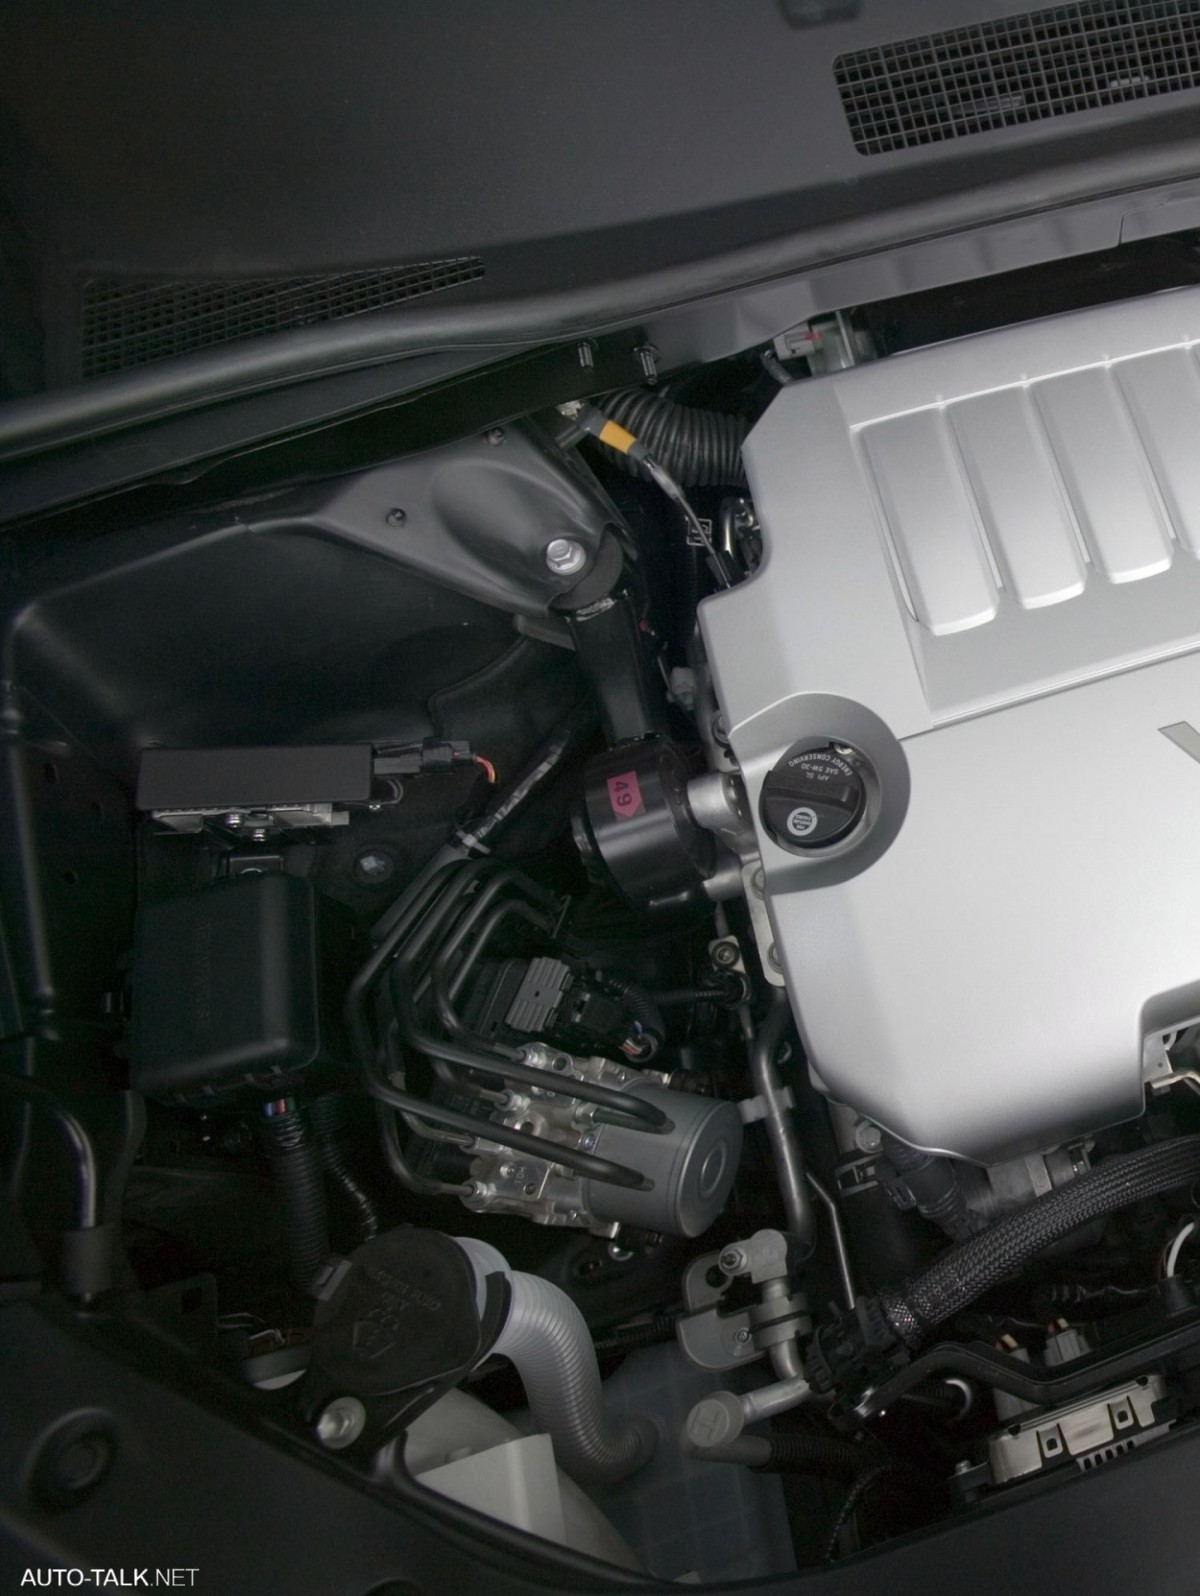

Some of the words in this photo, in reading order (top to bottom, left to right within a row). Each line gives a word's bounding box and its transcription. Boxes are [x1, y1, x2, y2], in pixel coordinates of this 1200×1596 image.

[788, 753, 830, 766] CONSERVING
[832, 756, 852, 776] ENERGY
[801, 763, 823, 772] 5W-30
[818, 773, 830, 781] API
[614, 781, 632, 807] 49
